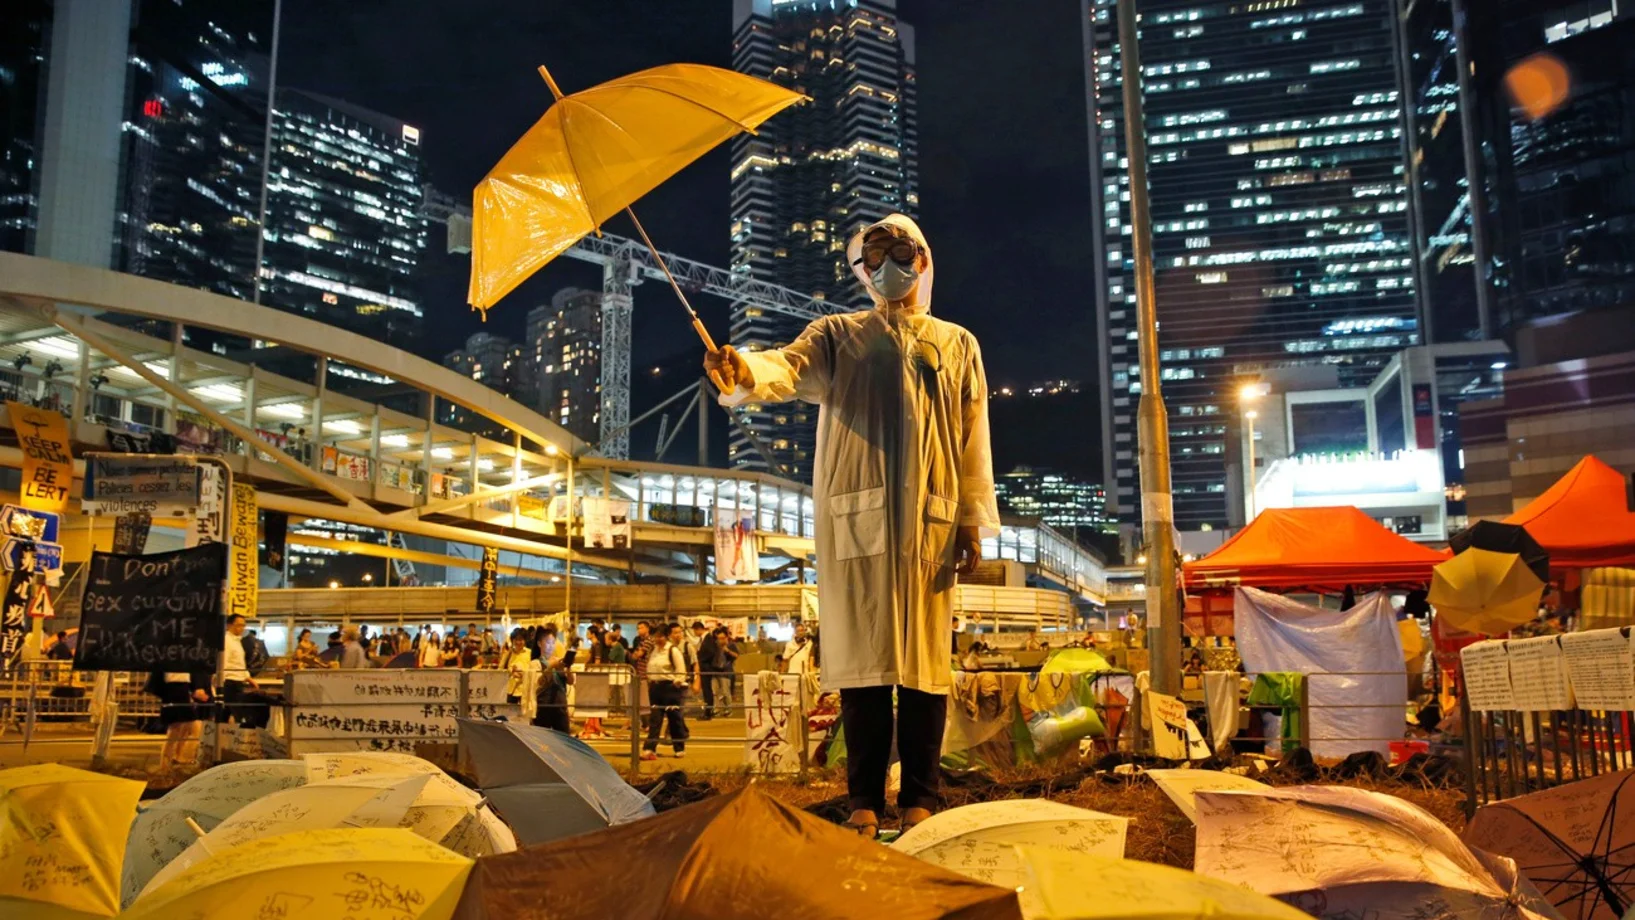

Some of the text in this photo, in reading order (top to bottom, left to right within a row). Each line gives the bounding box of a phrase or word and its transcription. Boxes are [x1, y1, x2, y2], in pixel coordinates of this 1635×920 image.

[22, 436, 62, 451] KEEP
[26, 447, 70, 464] CALM
[33, 467, 58, 483] BE
[25, 482, 68, 501] LERT
[100, 496, 158, 513] violences
[231, 552, 248, 613] Taiwan
[152, 616, 197, 639] ME
